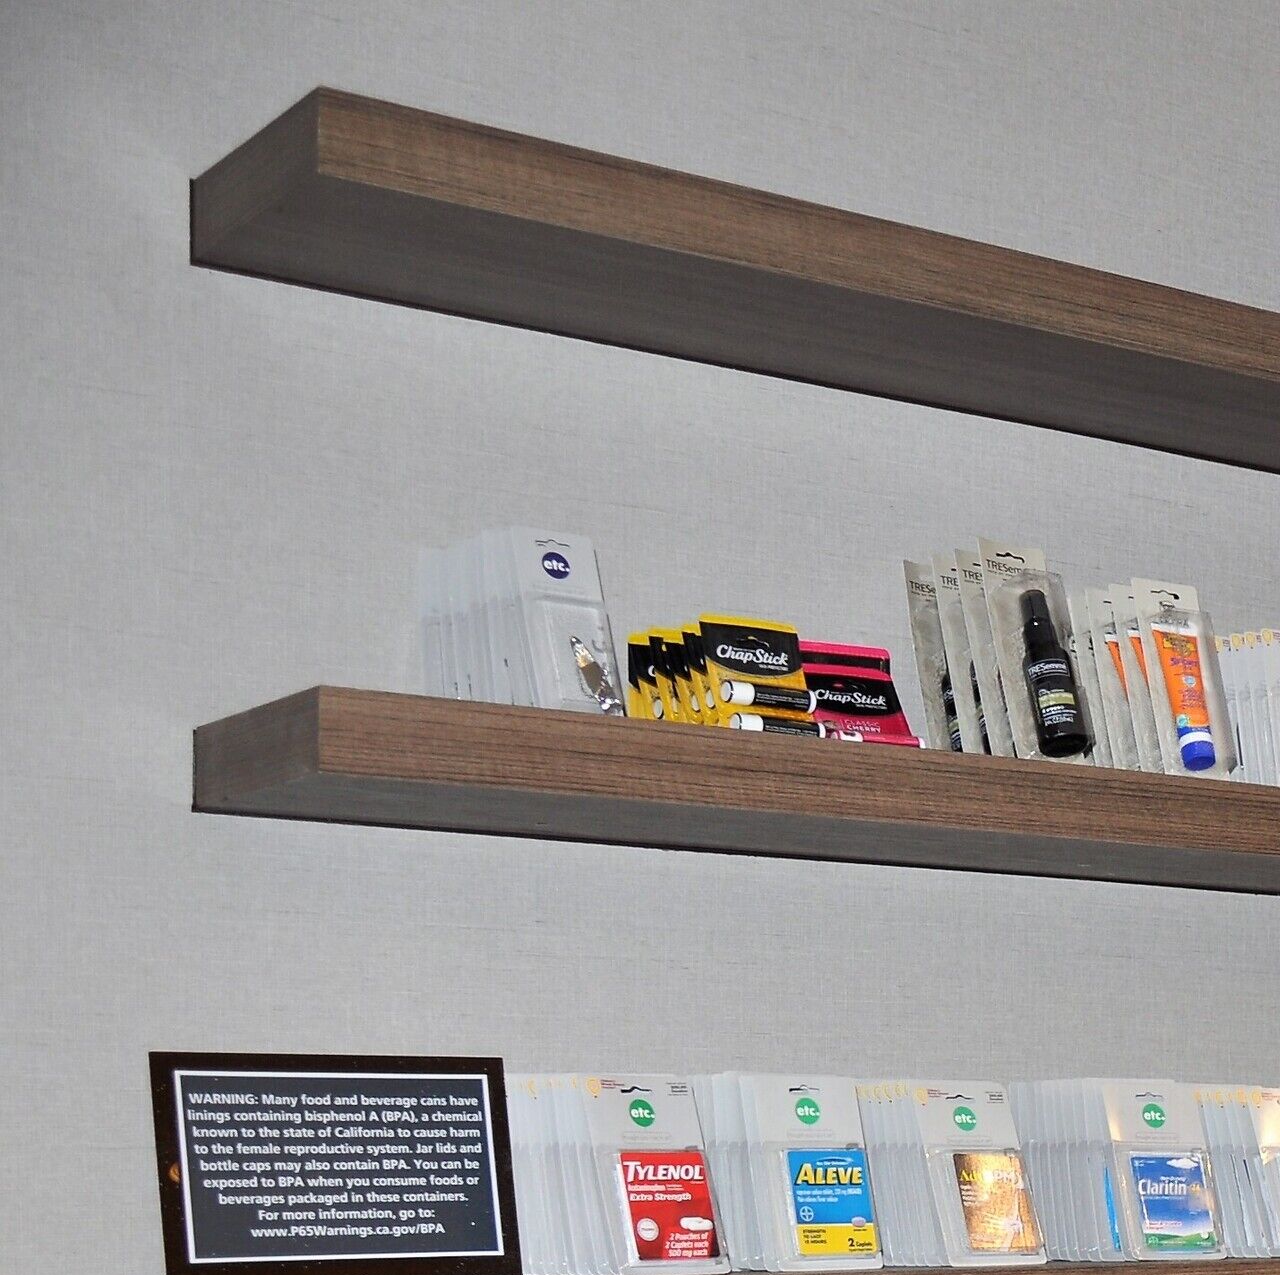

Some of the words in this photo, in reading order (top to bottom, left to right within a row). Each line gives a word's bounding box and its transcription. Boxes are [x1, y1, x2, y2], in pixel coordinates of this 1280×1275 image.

[543, 559, 570, 572] etc.
[716, 644, 789, 666] ChapStick
[815, 689, 886, 706] ChapStick
[846, 725, 881, 733] CHERRY
[188, 1094, 258, 1104] WARNING:
[261, 1094, 298, 1107] Many
[301, 1094, 331, 1105] food
[334, 1095, 358, 1105] and
[361, 1095, 418, 1108] beverage
[449, 1096, 478, 1105] have
[188, 1110, 230, 1123] linings
[234, 1110, 302, 1123] containing
[304, 1110, 366, 1124] bisphenol
[369, 1111, 379, 1121] A
[382, 1111, 418, 1123] (BPA),
[432, 1111, 482, 1121] chemical
[630, 1107, 656, 1119] etc.
[796, 1105, 820, 1116] etc.
[1143, 1110, 1166, 1121] etc.
[954, 1113, 977, 1124] etc.
[193, 1126, 238, 1137] known
[241, 1128, 255, 1137] to
[259, 1127, 280, 1137] the
[283, 1128, 314, 1137] state
[318, 1127, 331, 1137] of
[335, 1127, 394, 1137] California
[397, 1128, 410, 1137] to
[450, 1127, 480, 1137] harm
[194, 1144, 208, 1154] to
[211, 1143, 233, 1154] the
[236, 1143, 281, 1154] female
[284, 1143, 364, 1156] reproductive
[366, 1144, 412, 1156] system.
[416, 1144, 433, 1153] Jar
[436, 1142, 457, 1153] lids
[460, 1143, 482, 1153] and
[200, 1160, 239, 1170] bottle
[243, 1162, 271, 1173] caps
[274, 1162, 301, 1173] may
[305, 1160, 330, 1170] also
[334, 1159, 379, 1170] contain
[382, 1160, 411, 1169] BPA.
[414, 1160, 438, 1169] You
[464, 1159, 479, 1169] be
[623, 1161, 704, 1183] TYLENOL
[796, 1162, 864, 1185] ALEVE
[203, 1176, 258, 1190] exposed
[260, 1178, 275, 1187] to
[278, 1176, 304, 1187] BPA
[307, 1176, 343, 1186] when
[346, 1178, 370, 1189] you
[373, 1178, 427, 1186] consume
[430, 1175, 464, 1185] foods
[1138, 1178, 1187, 1195] Claritin
[219, 1194, 285, 1206] beverages
[288, 1192, 348, 1206] packaged
[352, 1192, 363, 1202] in
[366, 1192, 400, 1202] these
[403, 1191, 468, 1202] containers.
[630, 1192, 653, 1202] Extra
[654, 1192, 692, 1202] Strength
[258, 1210, 279, 1220] For
[282, 1212, 315, 1220] more
[319, 1208, 396, 1219] information,
[399, 1210, 415, 1220] go
[418, 1208, 435, 1217] to:
[250, 1224, 445, 1238] www.P65Warnings.ca.gov/BPA
[847, 1237, 855, 1247] 2
